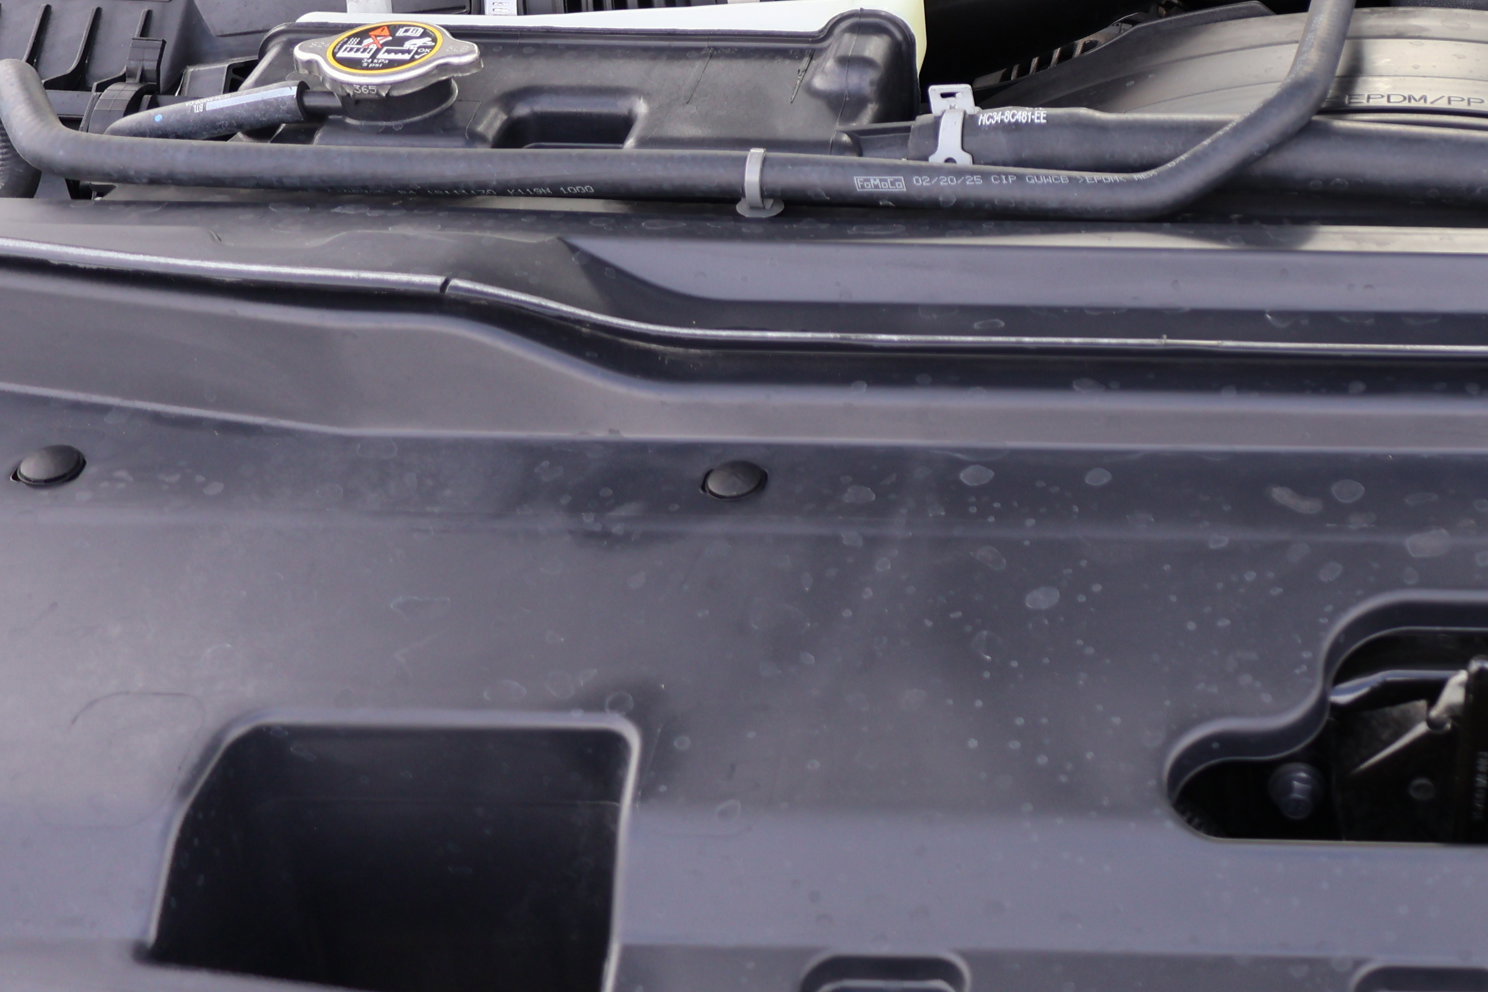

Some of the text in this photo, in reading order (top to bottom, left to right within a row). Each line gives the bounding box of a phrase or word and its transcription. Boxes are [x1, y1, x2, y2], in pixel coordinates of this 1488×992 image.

[353, 85, 377, 94] 365
[854, 176, 907, 191] FoMoCo
[913, 175, 983, 186] 02/20/25
[991, 175, 1016, 185] CIP
[560, 185, 595, 195] 1000
